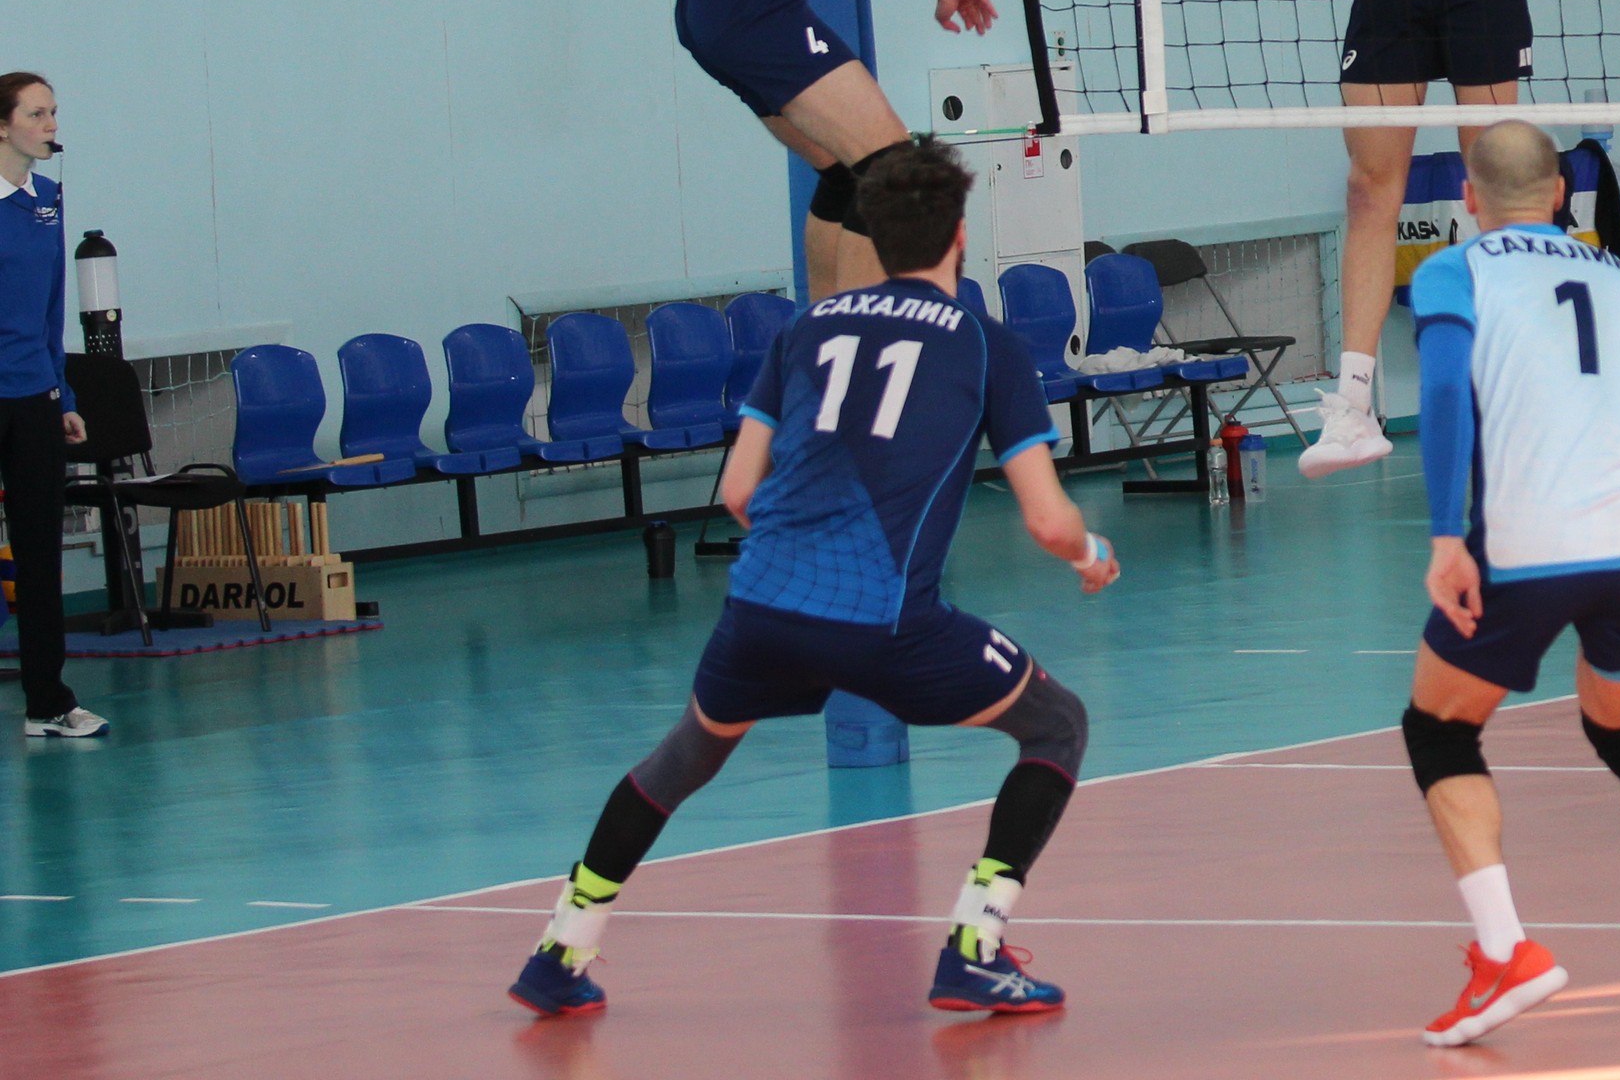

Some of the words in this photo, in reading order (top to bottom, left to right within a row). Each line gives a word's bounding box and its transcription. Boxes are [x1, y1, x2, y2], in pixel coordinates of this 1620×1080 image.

[806, 26, 830, 55] 4
[1397, 221, 1441, 241] KASA
[811, 293, 965, 332] САХАЛИН
[1555, 280, 1600, 375] 1
[814, 334, 924, 440] 11
[983, 628, 1019, 673] 11
